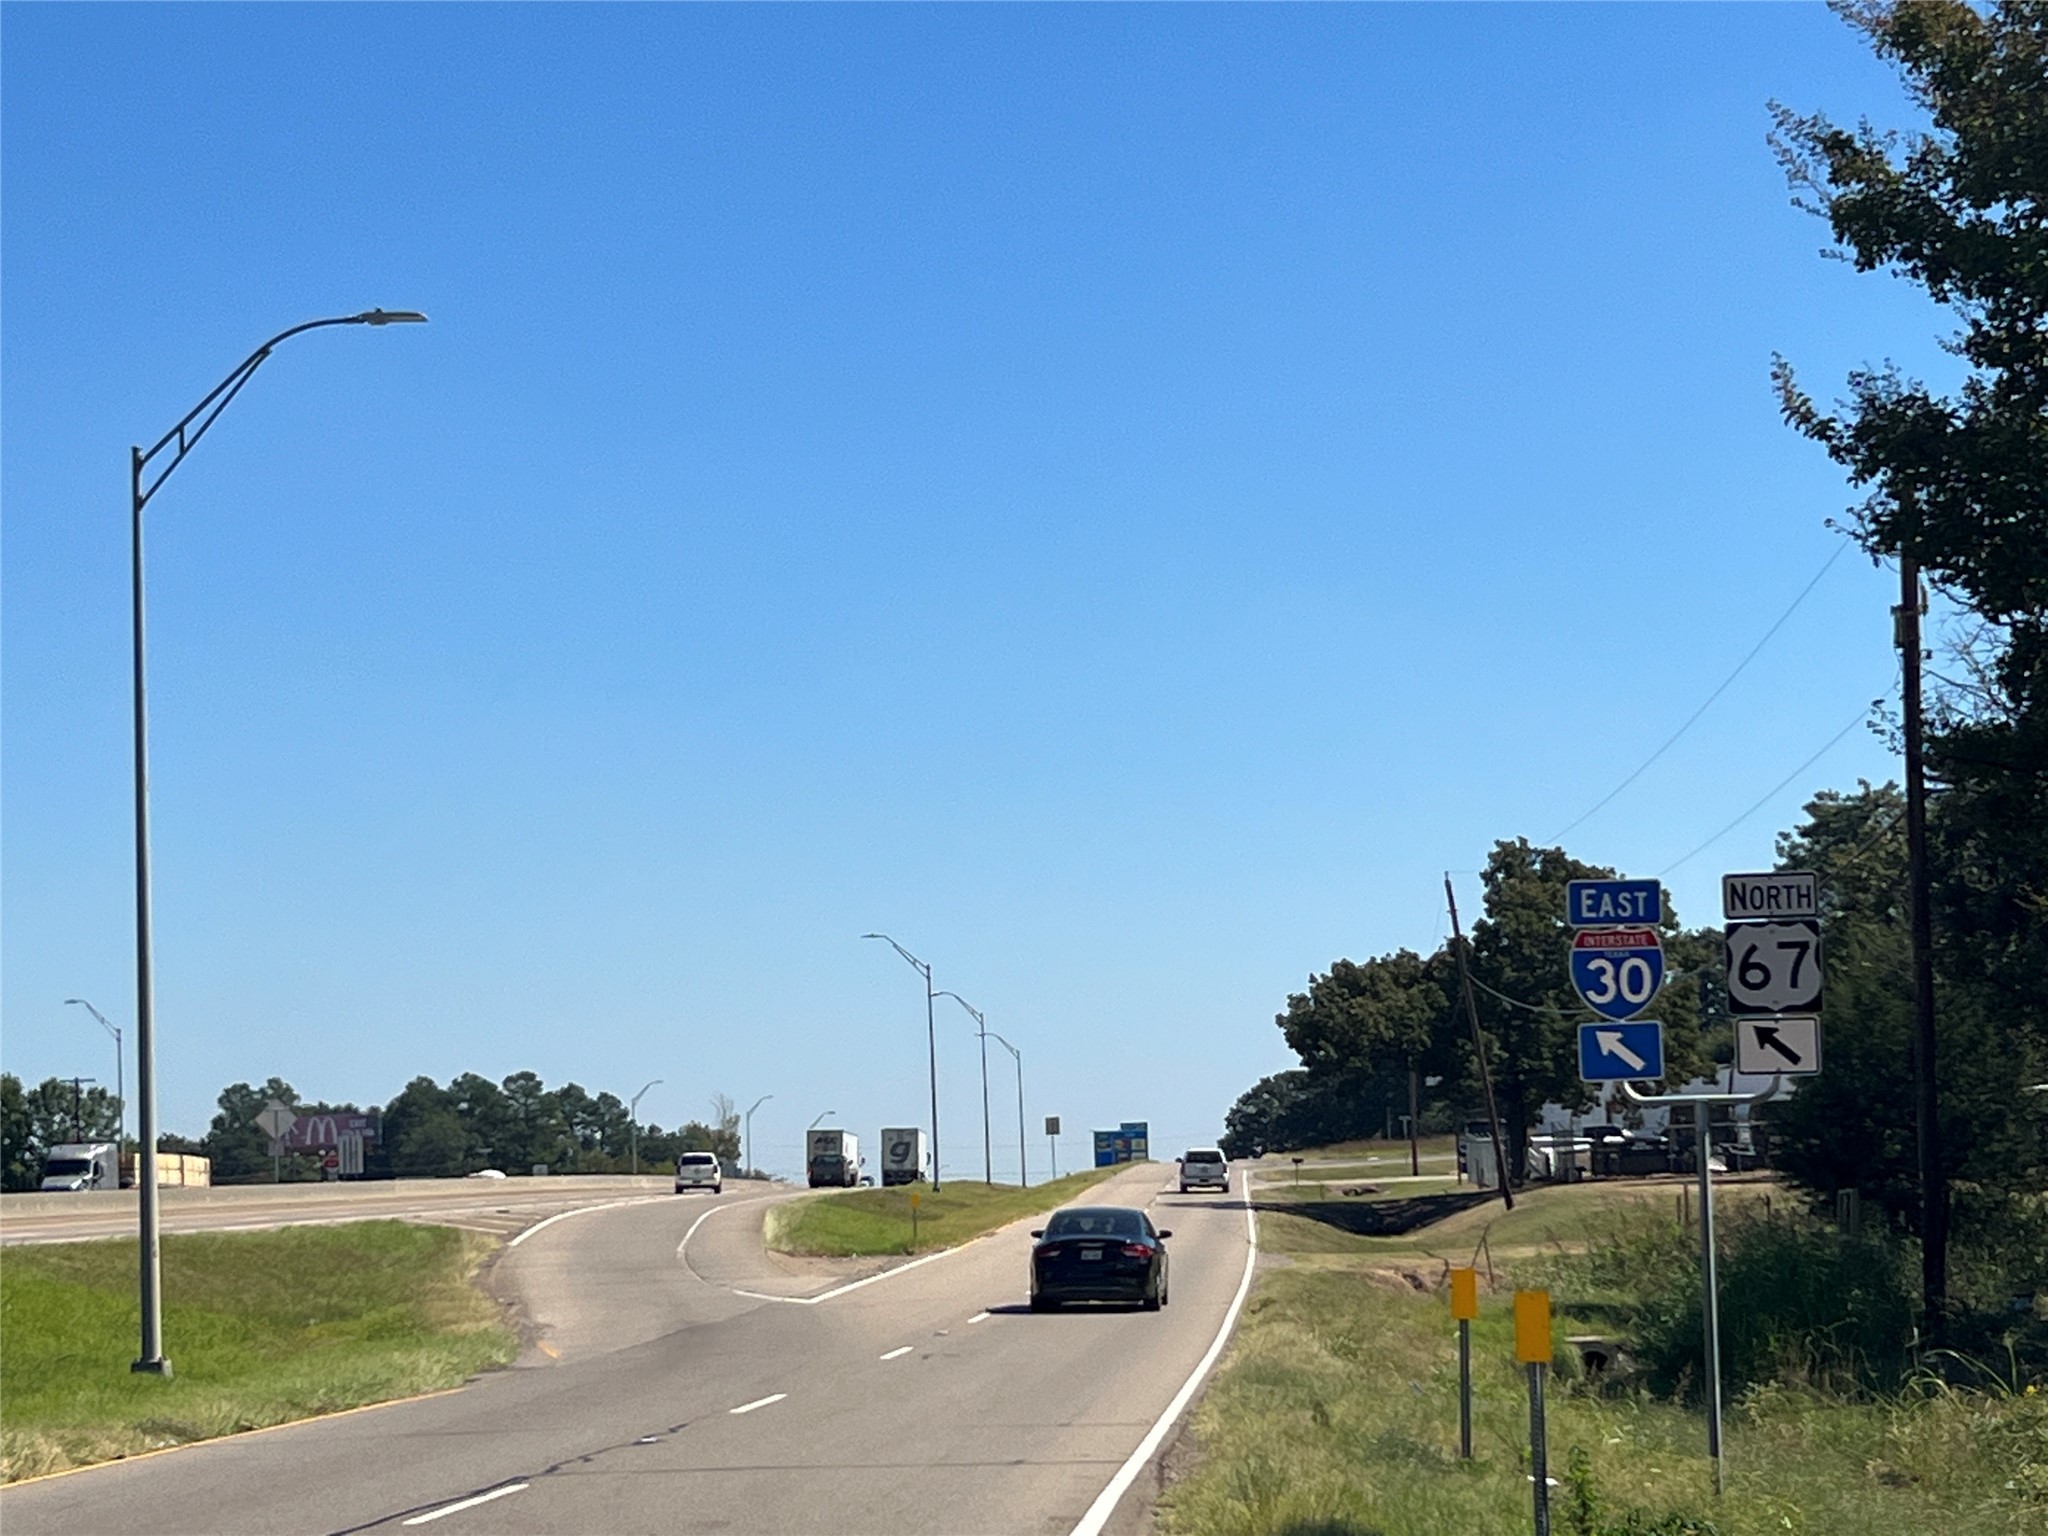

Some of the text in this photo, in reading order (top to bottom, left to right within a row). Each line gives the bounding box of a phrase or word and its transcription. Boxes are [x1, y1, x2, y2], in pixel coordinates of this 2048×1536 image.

[1581, 889, 1648, 918] EAST
[1731, 882, 1812, 911] NORTH
[1583, 934, 1648, 947] INTERSTATE
[1585, 957, 1653, 1004] 30
[1738, 941, 1810, 991] 67
